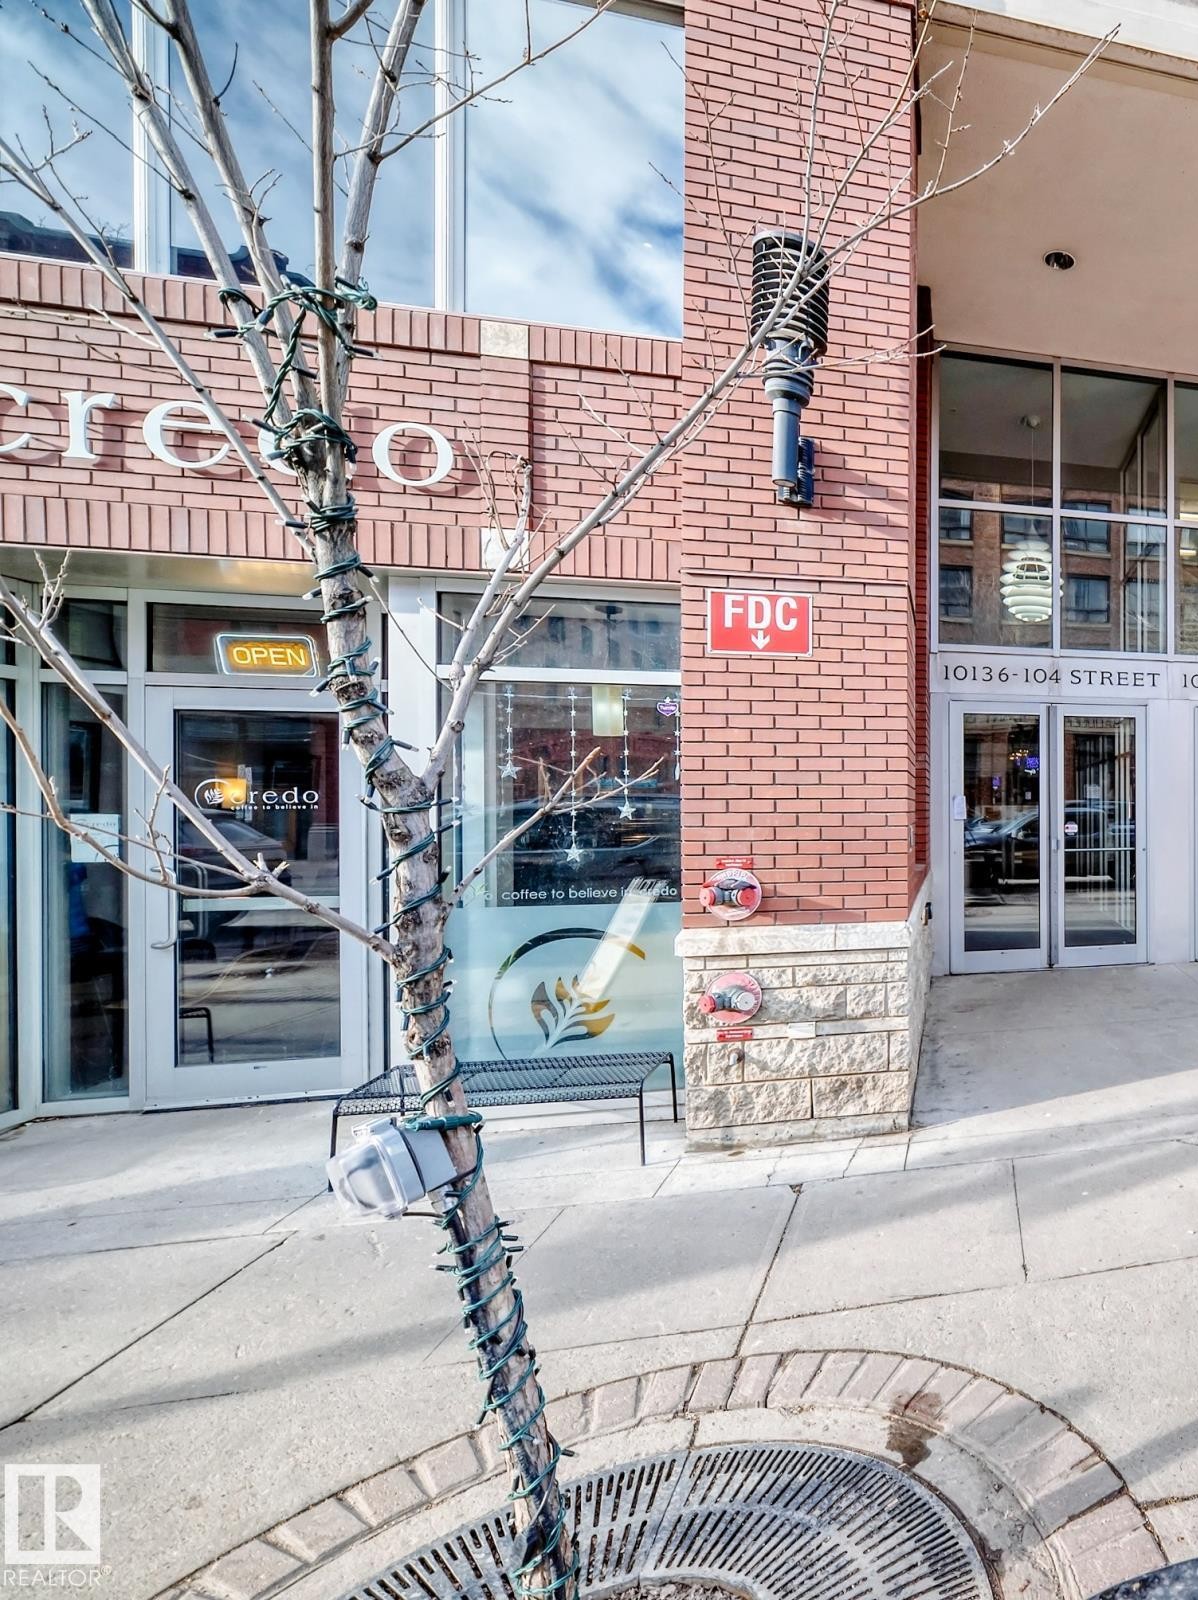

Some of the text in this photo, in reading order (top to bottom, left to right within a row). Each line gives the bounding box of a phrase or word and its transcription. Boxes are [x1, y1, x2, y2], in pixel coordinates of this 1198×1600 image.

[724, 594, 798, 631] FDC
[232, 647, 306, 666] OPEN
[1070, 669, 1163, 688] STREET
[231, 786, 319, 804] credo
[501, 888, 548, 900] coffee
[552, 888, 565, 899] to
[569, 886, 617, 899] believe
